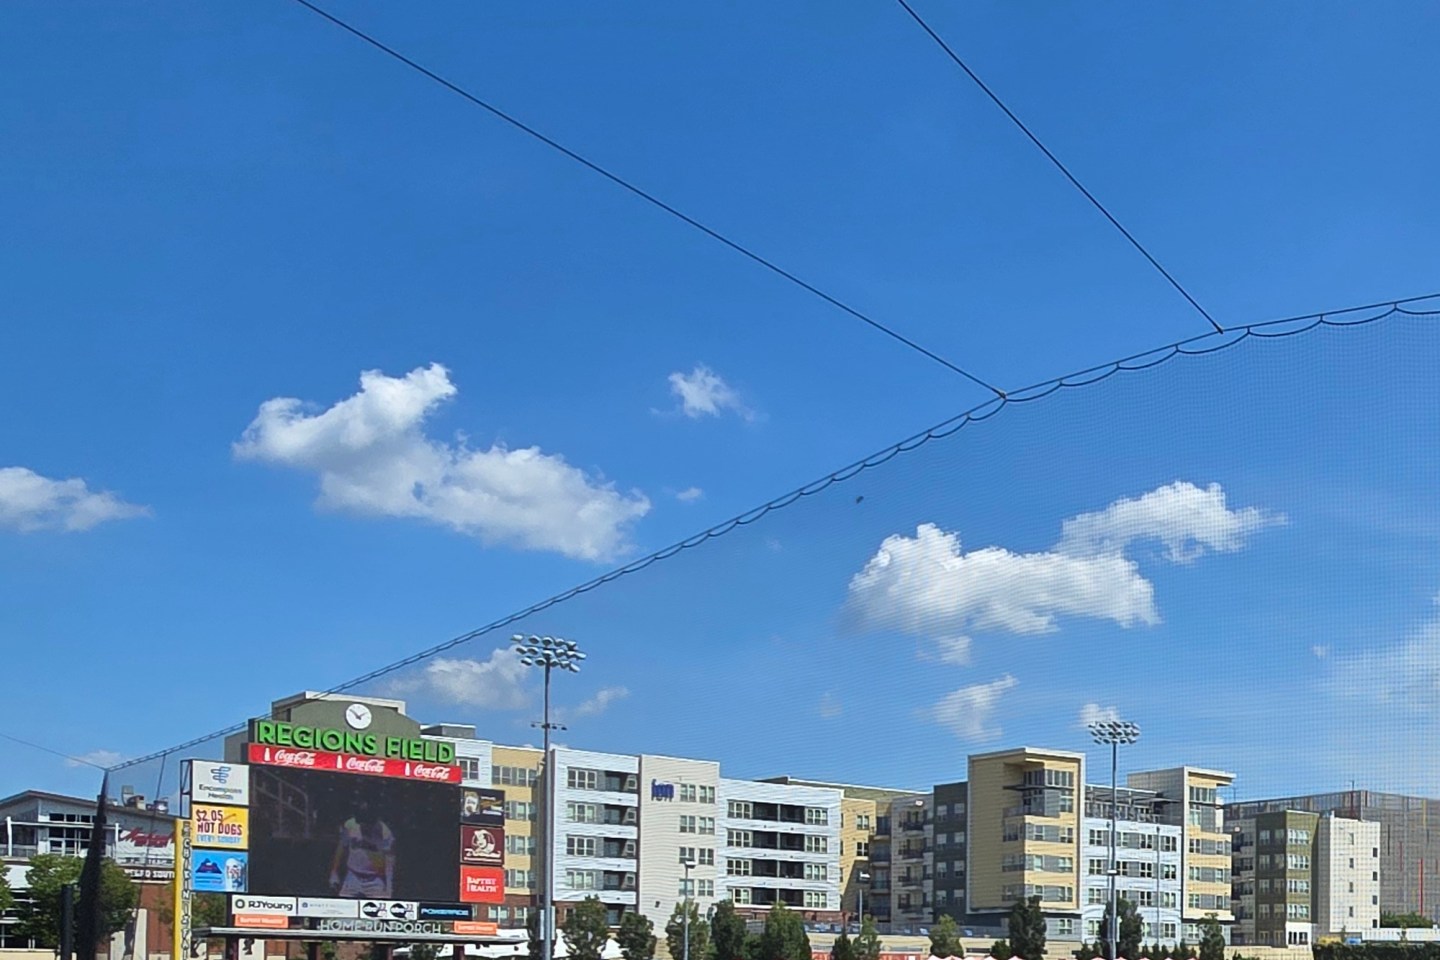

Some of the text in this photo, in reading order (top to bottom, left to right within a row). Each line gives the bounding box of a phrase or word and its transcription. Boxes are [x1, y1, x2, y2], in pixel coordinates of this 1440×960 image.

[257, 720, 455, 763] REGIONS FIELD
[346, 757, 385, 773] Coca-Cola
[413, 764, 451, 780] Coca-Cola
[196, 809, 224, 822] $2.05
[197, 822, 243, 836] HOT DOGS
[320, 919, 441, 935] HOME RUN PORCH
